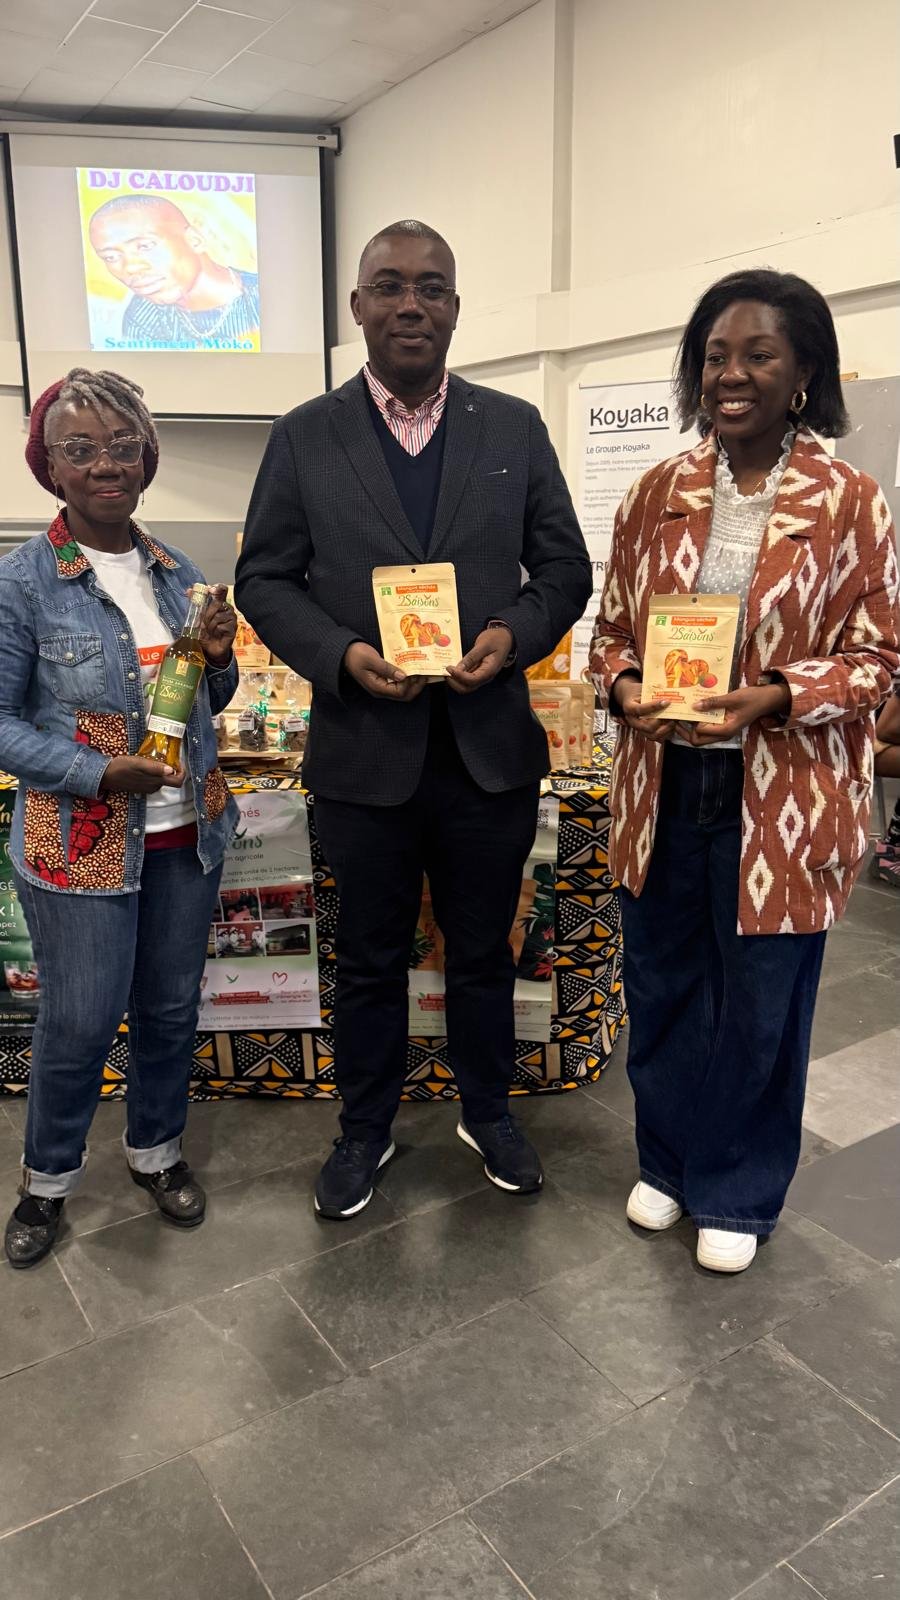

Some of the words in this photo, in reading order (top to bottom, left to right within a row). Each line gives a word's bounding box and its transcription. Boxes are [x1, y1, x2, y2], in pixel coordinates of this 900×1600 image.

[89, 170, 120, 188] DJ
[128, 172, 254, 193] CALOUDJI
[104, 337, 196, 350] Sentiment
[590, 402, 669, 429] Koyaka
[586, 446, 594, 455] Le
[595, 445, 622, 454] Groupe
[622, 442, 651, 453] Koyaka
[668, 626, 716, 642] 2Saisons
[141, 651, 160, 661] ue
[240, 807, 260, 819] nés
[234, 854, 264, 863] agricole
[0, 922, 17, 930] pez
